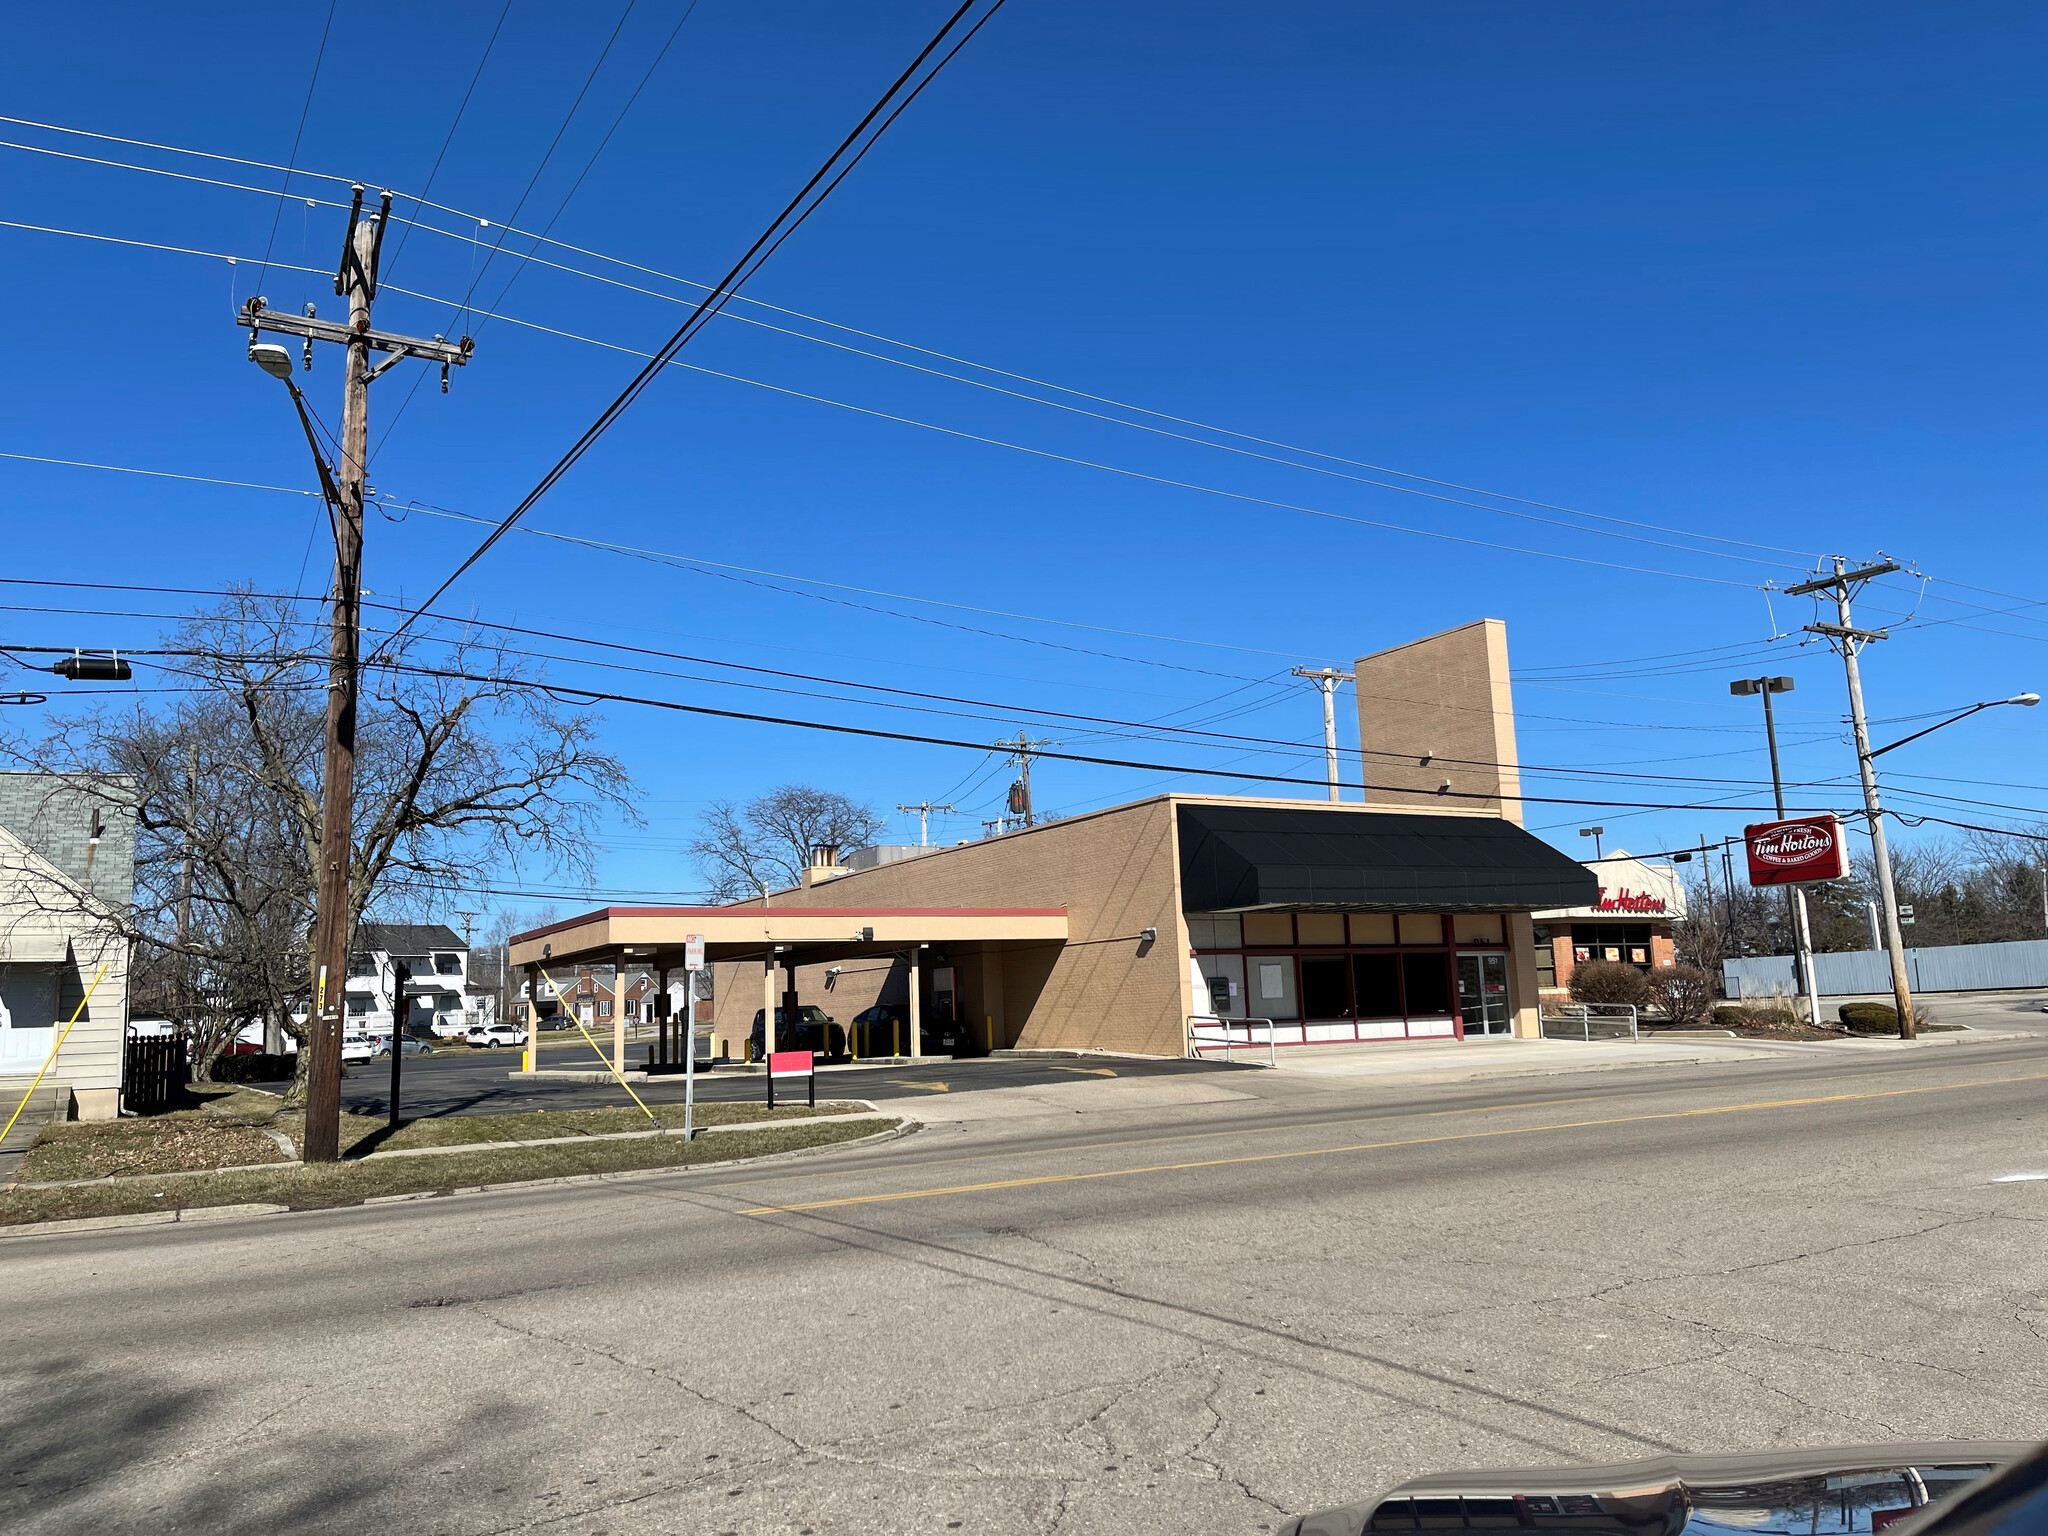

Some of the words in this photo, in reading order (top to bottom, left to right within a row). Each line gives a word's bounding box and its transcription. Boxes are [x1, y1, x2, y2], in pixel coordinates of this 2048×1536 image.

[1753, 837, 1779, 856] Tim
[1780, 833, 1830, 853] Hortons
[1762, 853, 1781, 863] COFFEE
[1787, 855, 1804, 864] BAKED
[1804, 847, 1823, 860] GOODS
[1616, 887, 1667, 910] Hortons
[687, 935, 696, 943] NO
